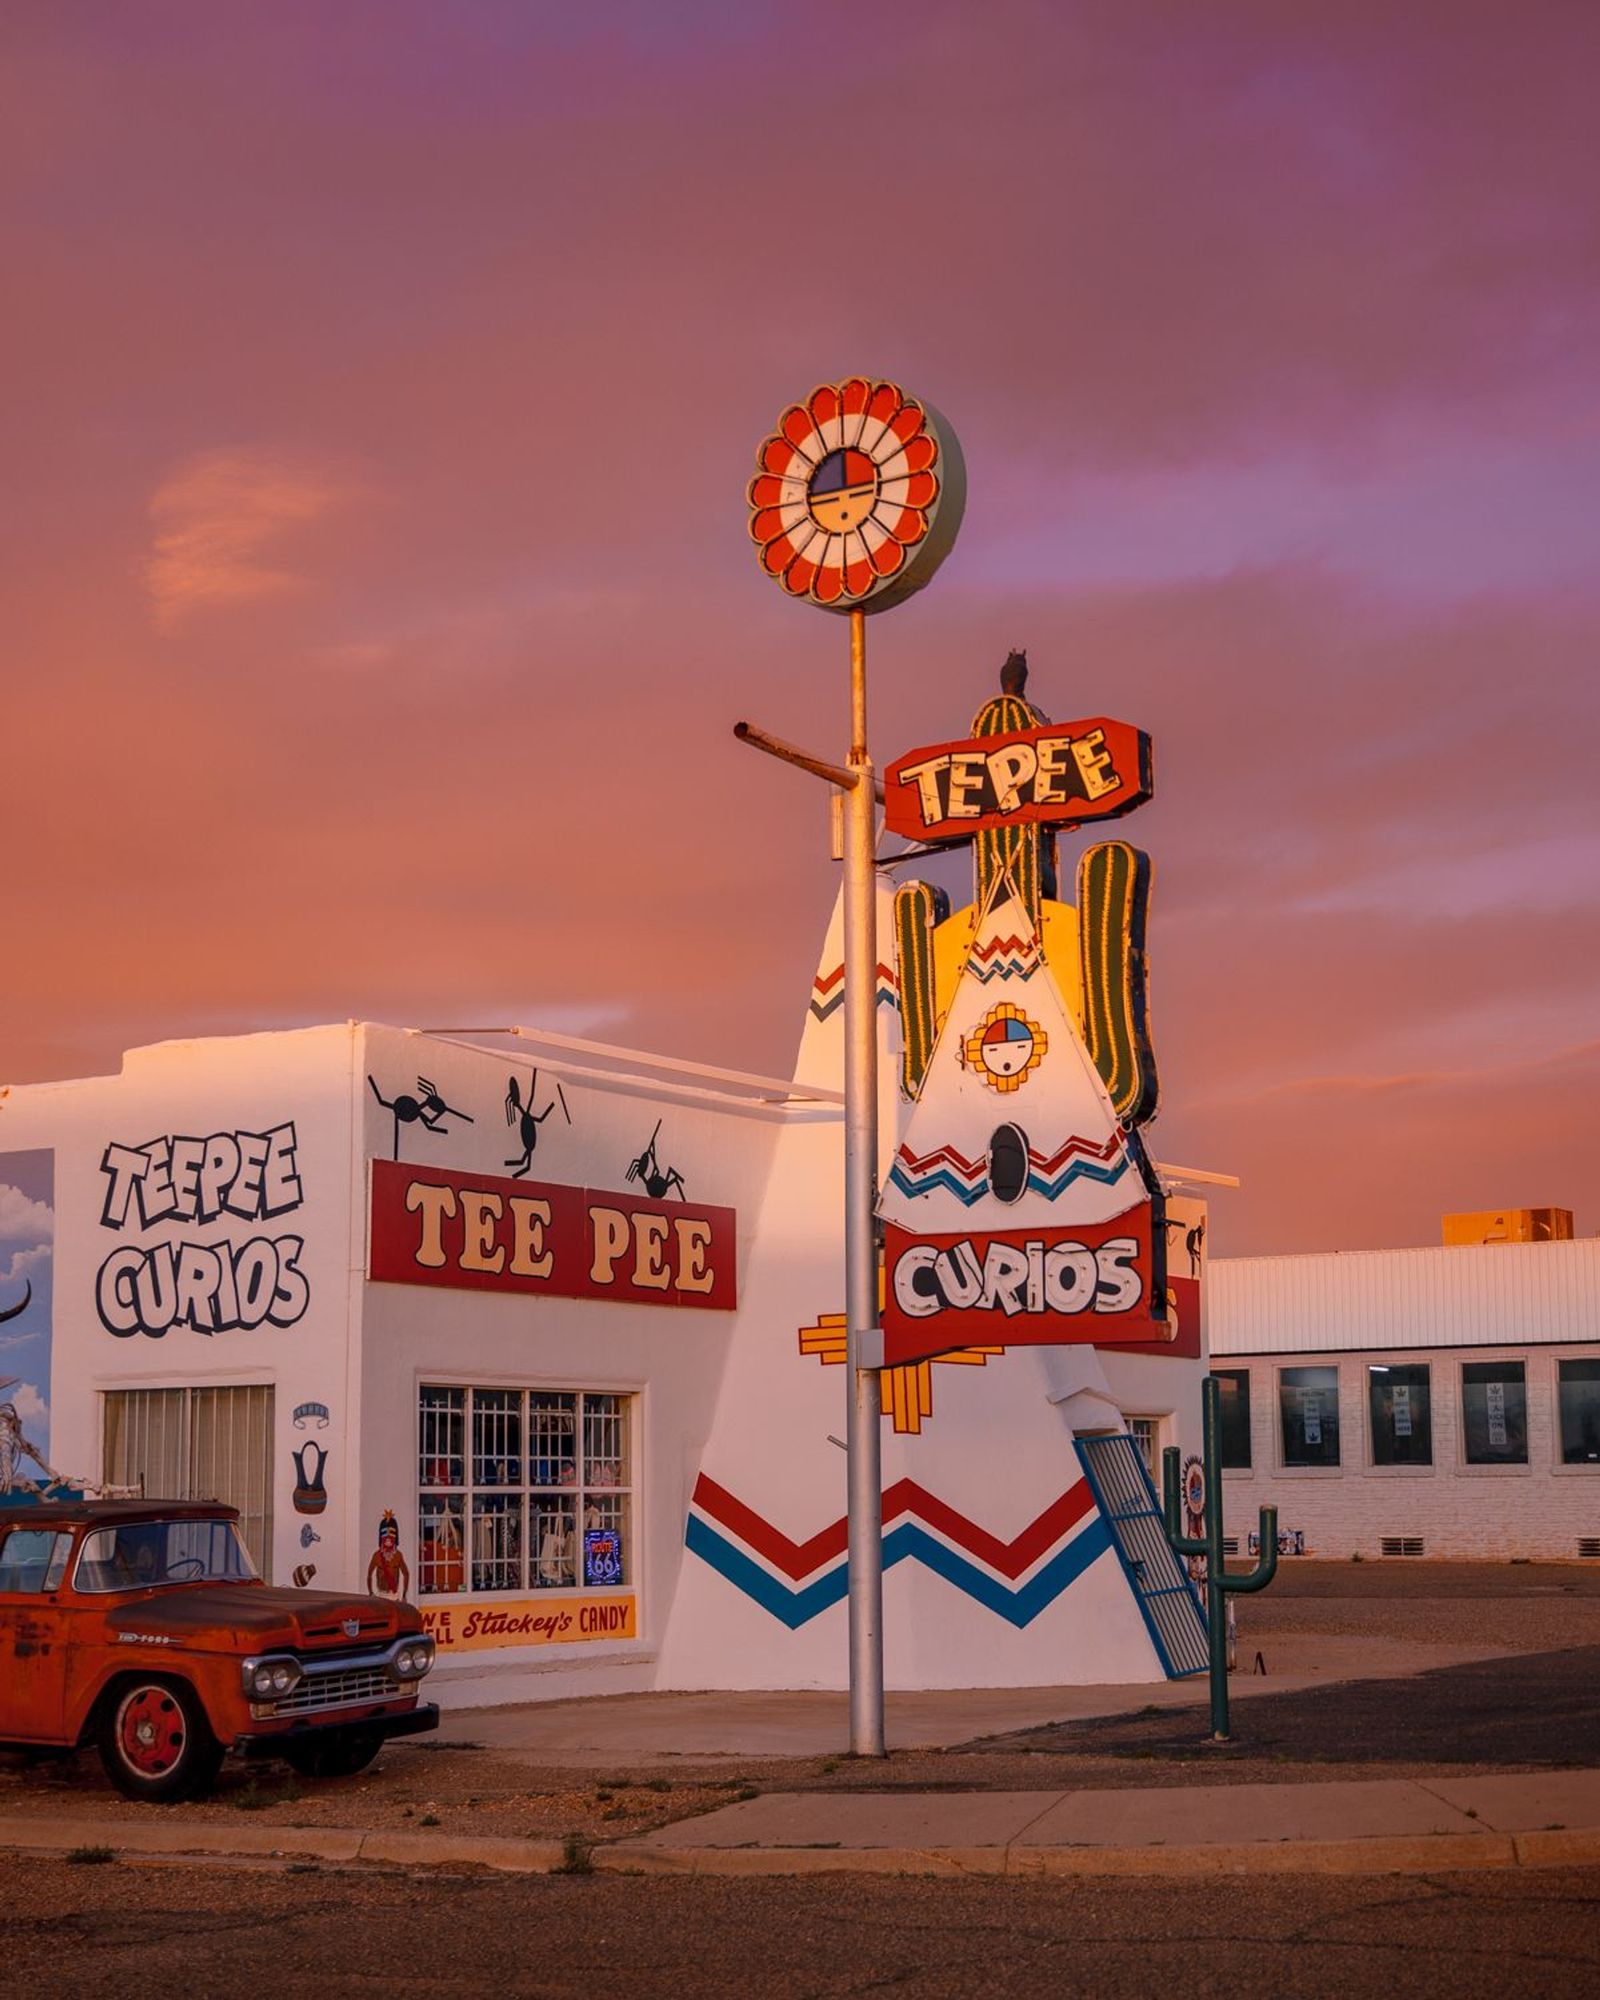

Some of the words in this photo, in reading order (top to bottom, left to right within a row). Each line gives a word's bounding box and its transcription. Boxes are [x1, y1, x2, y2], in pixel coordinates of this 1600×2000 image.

[899, 728, 1124, 827] TEPEE
[100, 1121, 304, 1231] TEEPEE
[406, 1181, 553, 1278] TEE
[589, 1207, 714, 1294] PEE
[893, 1237, 1143, 1318] CURIOS
[96, 1234, 310, 1338] CURIOS
[591, 1542, 613, 1552] ROUTE
[594, 1553, 614, 1574] 66
[419, 1611, 451, 1627] WE
[462, 1610, 573, 1639] Stuckey's
[579, 1605, 628, 1633] CANDY
